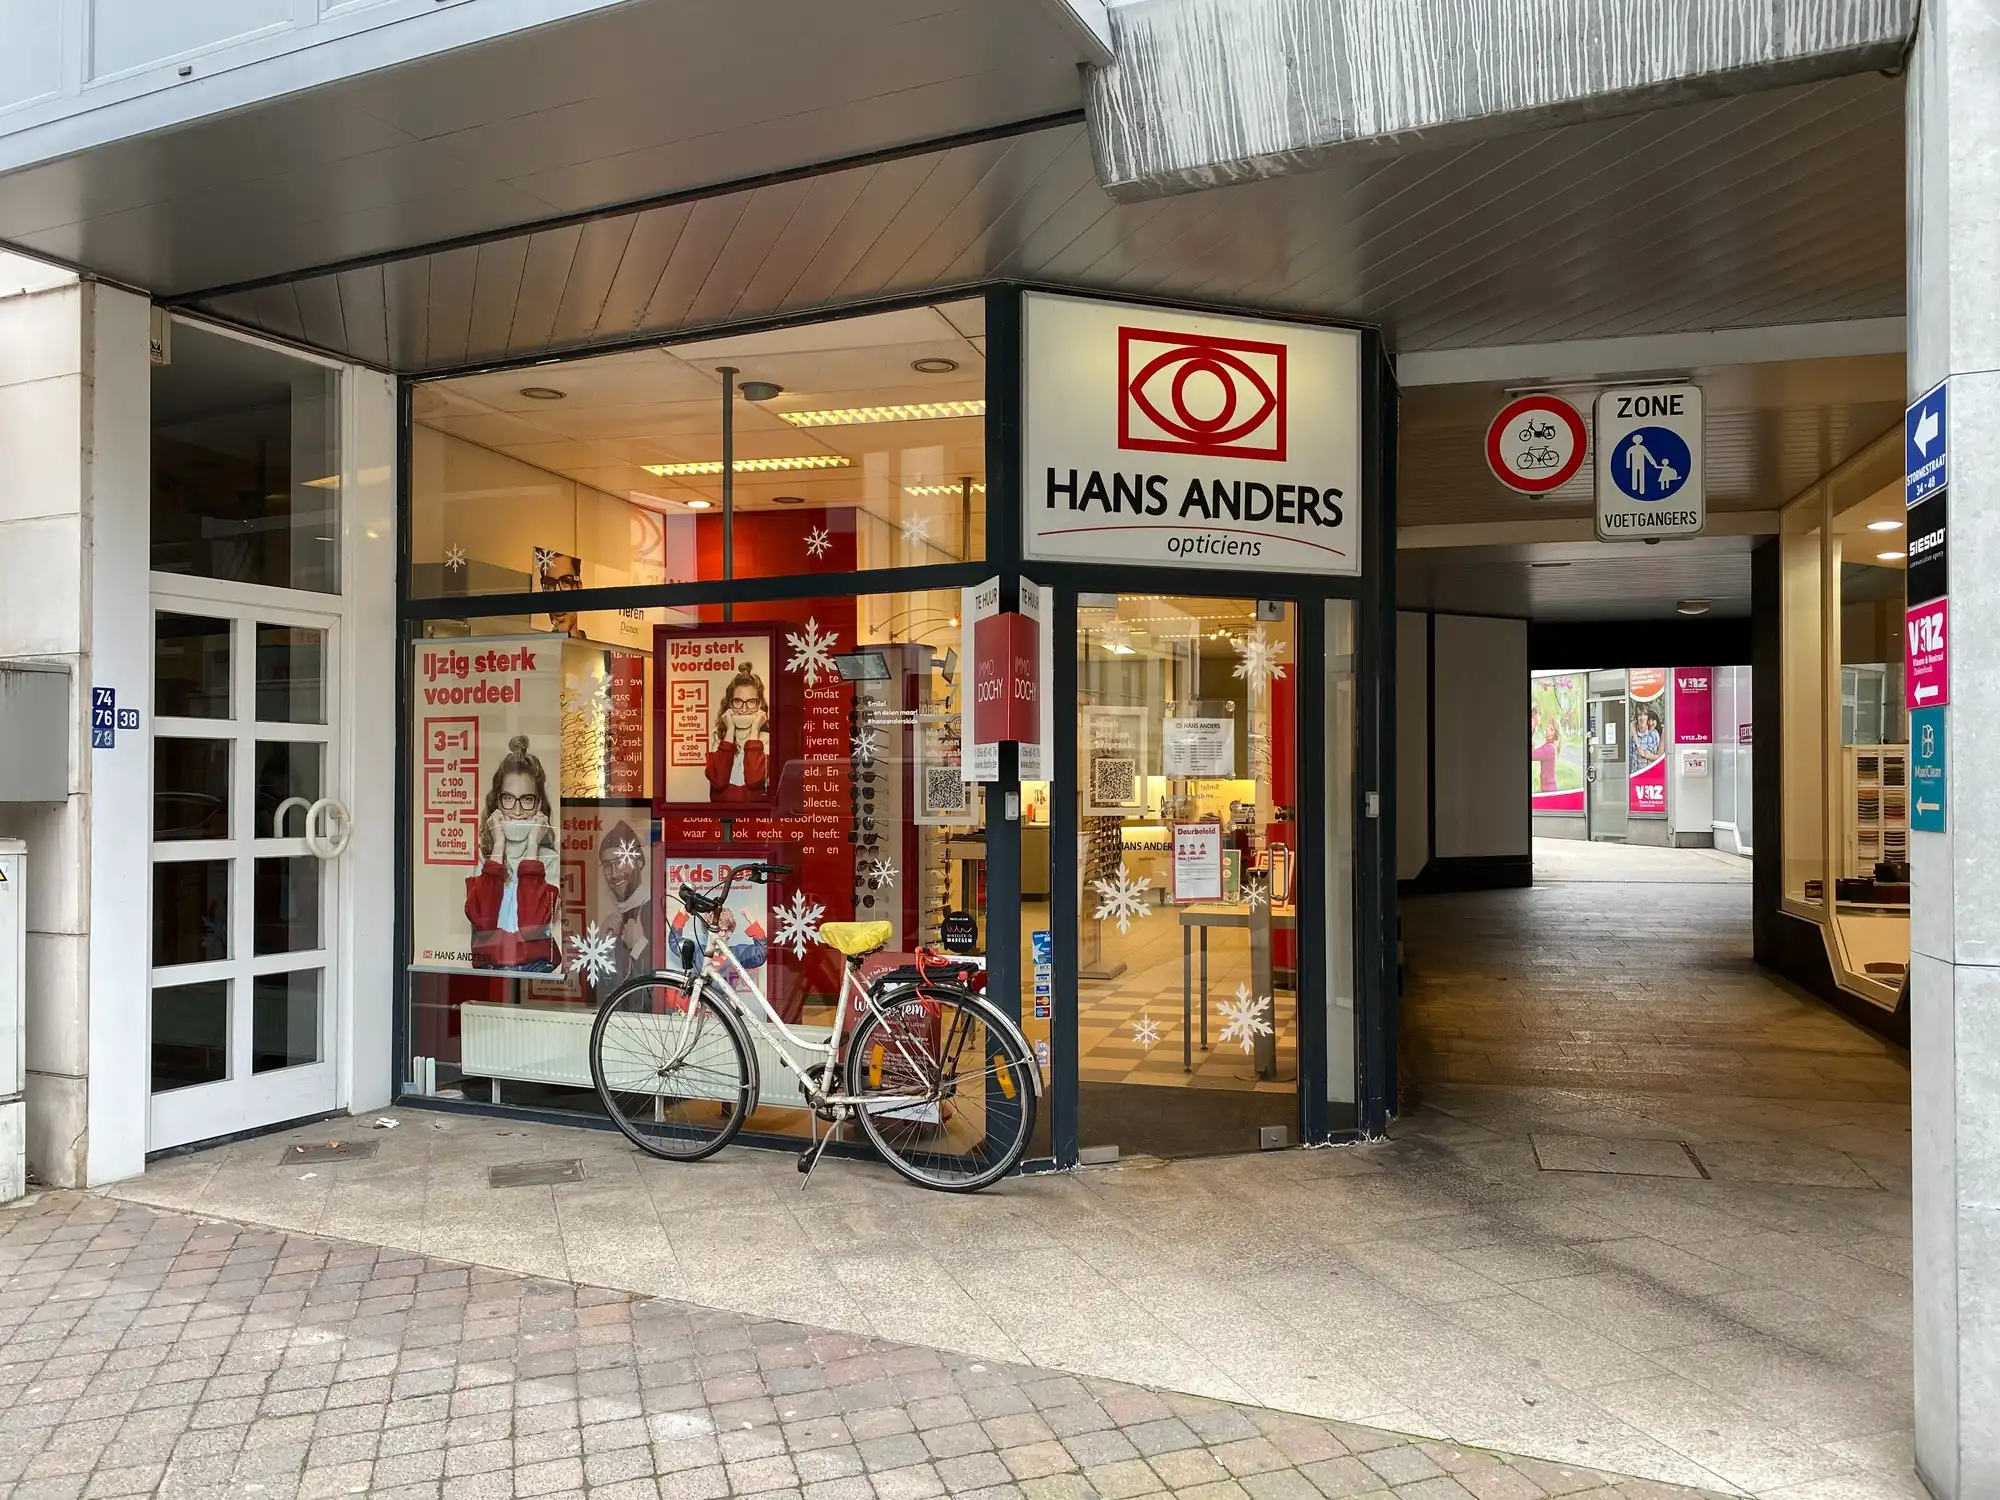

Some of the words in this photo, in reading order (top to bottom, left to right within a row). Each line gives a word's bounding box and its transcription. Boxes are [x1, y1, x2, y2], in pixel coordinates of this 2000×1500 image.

[1617, 394, 1684, 418] ZONE
[1916, 482, 1924, 496] 34
[1928, 476, 1936, 489] 48
[1047, 467, 1168, 516] HANS
[1178, 478, 1344, 528] ANDERS
[1605, 511, 1697, 528] VOETGANGERS
[1167, 535, 1262, 558] opticiens
[975, 595, 982, 610] TE
[982, 587, 998, 608] HUUR
[1021, 587, 1029, 605] TE
[1028, 590, 1040, 611] HUUR
[671, 641, 702, 659] IJzig
[705, 640, 744, 655] sterk
[424, 649, 469, 682] IJzig
[475, 647, 537, 672] sterk
[671, 657, 735, 672] voordeel
[978, 658, 995, 677] IMMO
[829, 674, 839, 683] te
[96, 689, 113, 706] 74
[424, 678, 521, 705] voordeel
[678, 688, 702, 701] 3=1
[804, 689, 840, 699] Omdat
[978, 677, 1004, 703] DOCHY
[1014, 678, 1038, 703] DOCHY
[95, 709, 113, 726] 76
[813, 706, 840, 714] moet
[120, 710, 137, 727] 38
[823, 721, 839, 730] het
[94, 730, 113, 746] 78
[434, 730, 469, 751] 3=1
[806, 737, 839, 748] ijveren
[447, 760, 458, 771] of
[803, 767, 822, 776] eld.
[826, 767, 840, 776] En
[436, 788, 468, 800] korting
[823, 783, 840, 792] Uit
[447, 810, 457, 821] of
[562, 815, 603, 831] sterk
[756, 829, 783, 838] recht
[790, 830, 804, 841] op
[812, 829, 840, 838] heeft:
[436, 838, 467, 850] korting
[1143, 842, 1173, 851] ANDER
[669, 864, 714, 884] Kids
[434, 951, 455, 961] HANS
